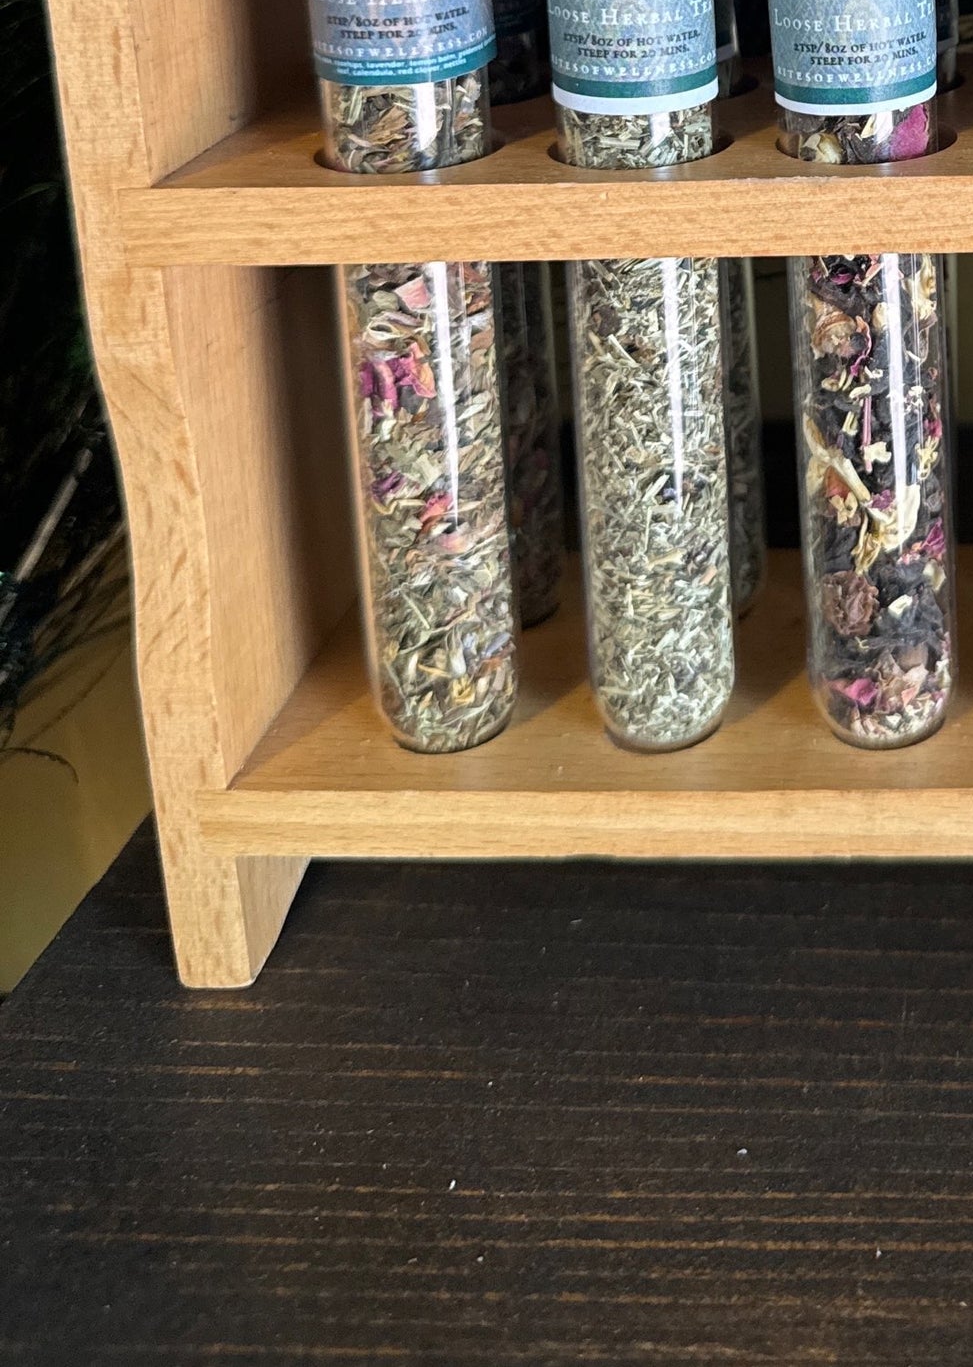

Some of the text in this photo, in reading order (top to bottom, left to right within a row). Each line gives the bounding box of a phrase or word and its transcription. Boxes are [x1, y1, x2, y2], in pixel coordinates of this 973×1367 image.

[384, 17, 400, 27] OF
[600, 8, 683, 26] HERBAL
[773, 8, 823, 32] LOOSE
[833, 12, 913, 33] HERBAL
[339, 28, 375, 40] STEEP
[378, 29, 404, 40] FOR
[616, 37, 633, 47] OF
[636, 36, 662, 46] HOT
[850, 43, 866, 54] OF
[869, 41, 894, 52] HOT
[577, 47, 611, 60] STEEP
[613, 50, 637, 59] FOR
[641, 49, 657, 59] 20
[810, 55, 845, 66] STEEP
[847, 56, 872, 65] FOR
[874, 54, 889, 64] 20
